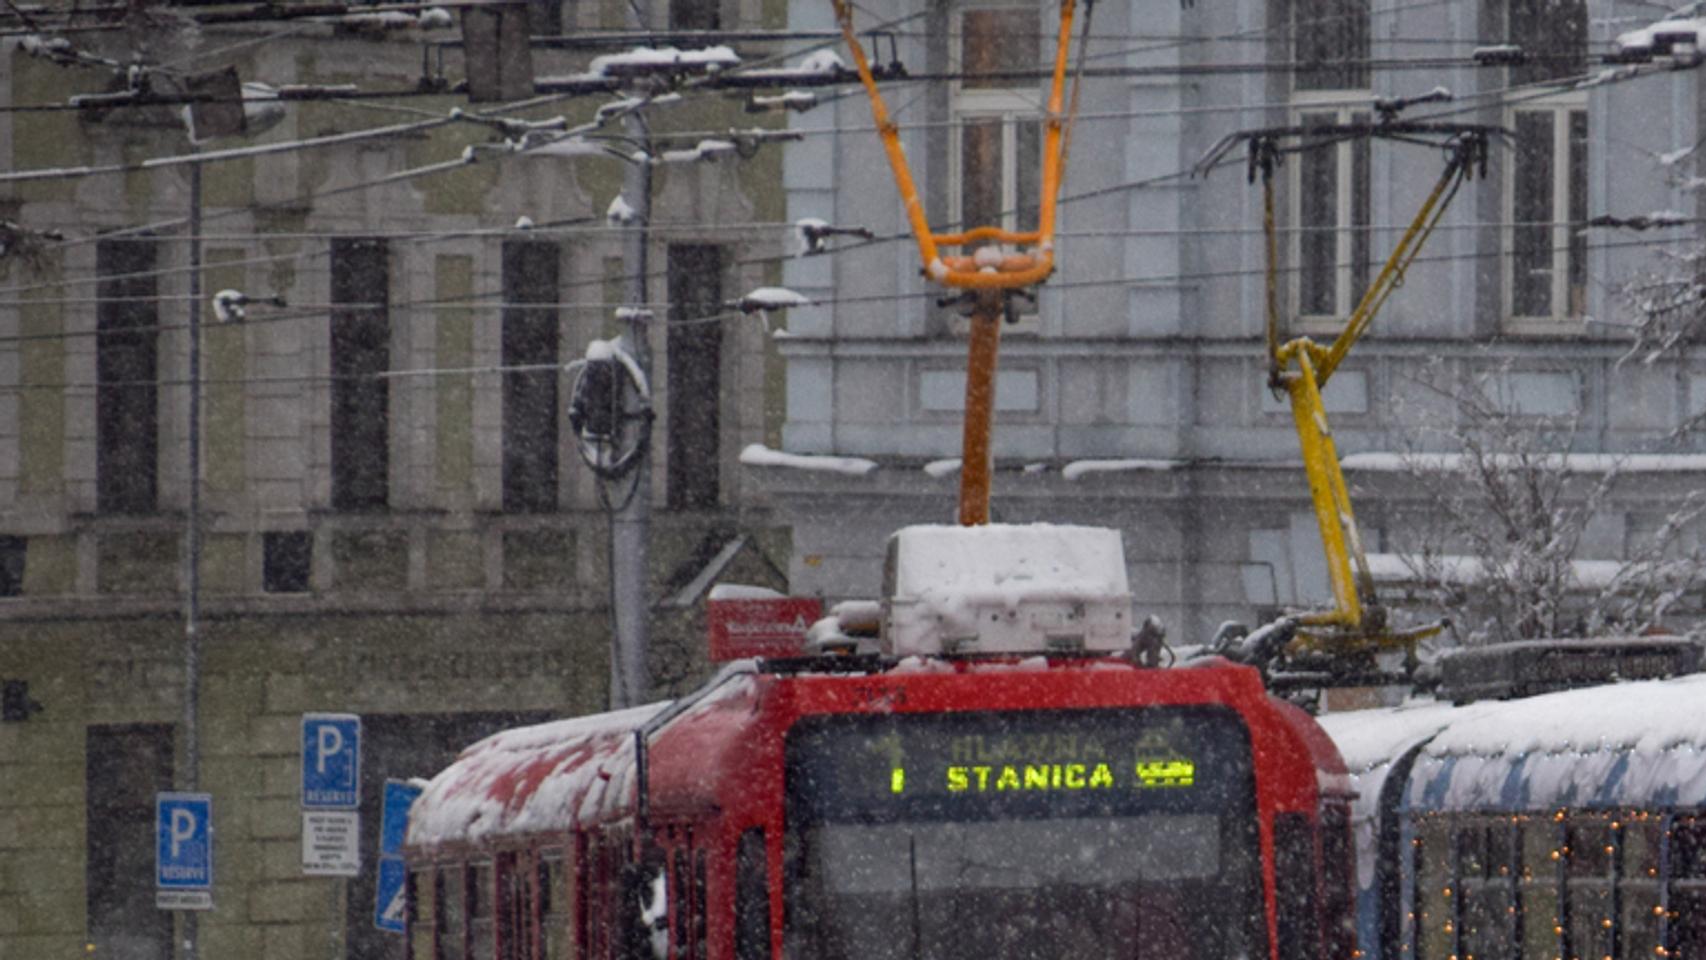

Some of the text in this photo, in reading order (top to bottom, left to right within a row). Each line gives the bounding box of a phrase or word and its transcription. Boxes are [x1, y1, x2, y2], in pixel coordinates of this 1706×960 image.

[317, 725, 342, 773] P
[946, 763, 1113, 792] STANICA
[171, 808, 196, 857] P
